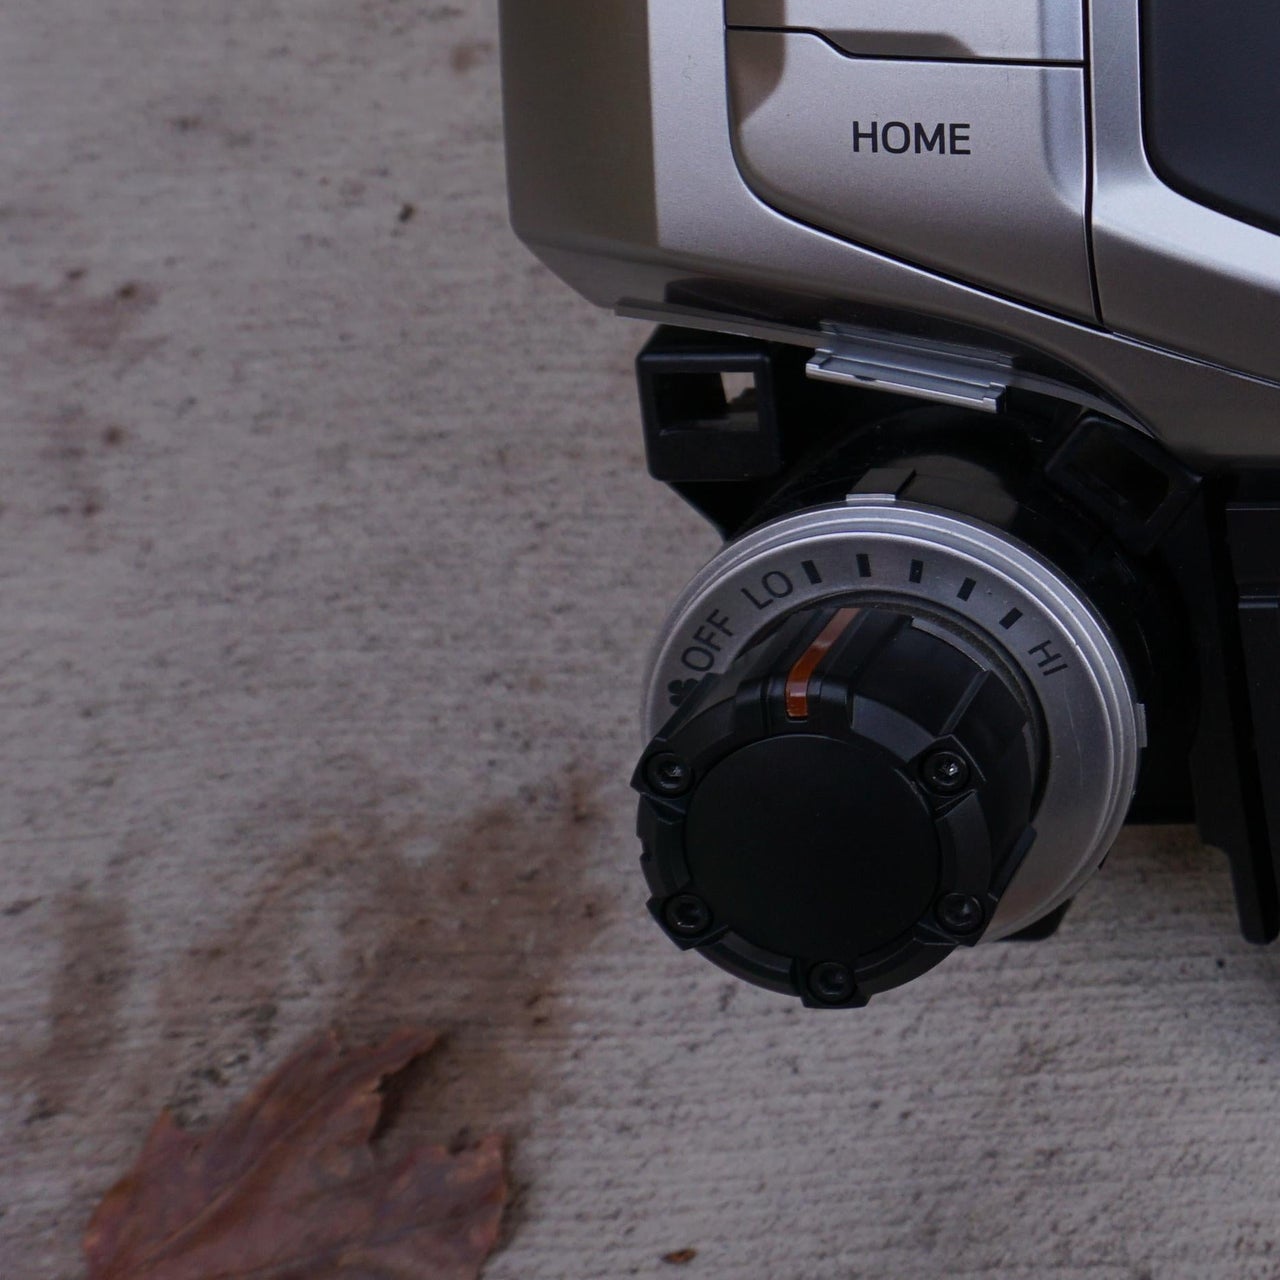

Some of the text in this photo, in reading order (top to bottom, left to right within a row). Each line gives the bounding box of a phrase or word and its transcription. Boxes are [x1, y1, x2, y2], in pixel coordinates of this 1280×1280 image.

[852, 121, 972, 155] HOME
[740, 569, 795, 611] LO
[681, 609, 735, 673] OFF
[1027, 639, 1068, 677] HI
